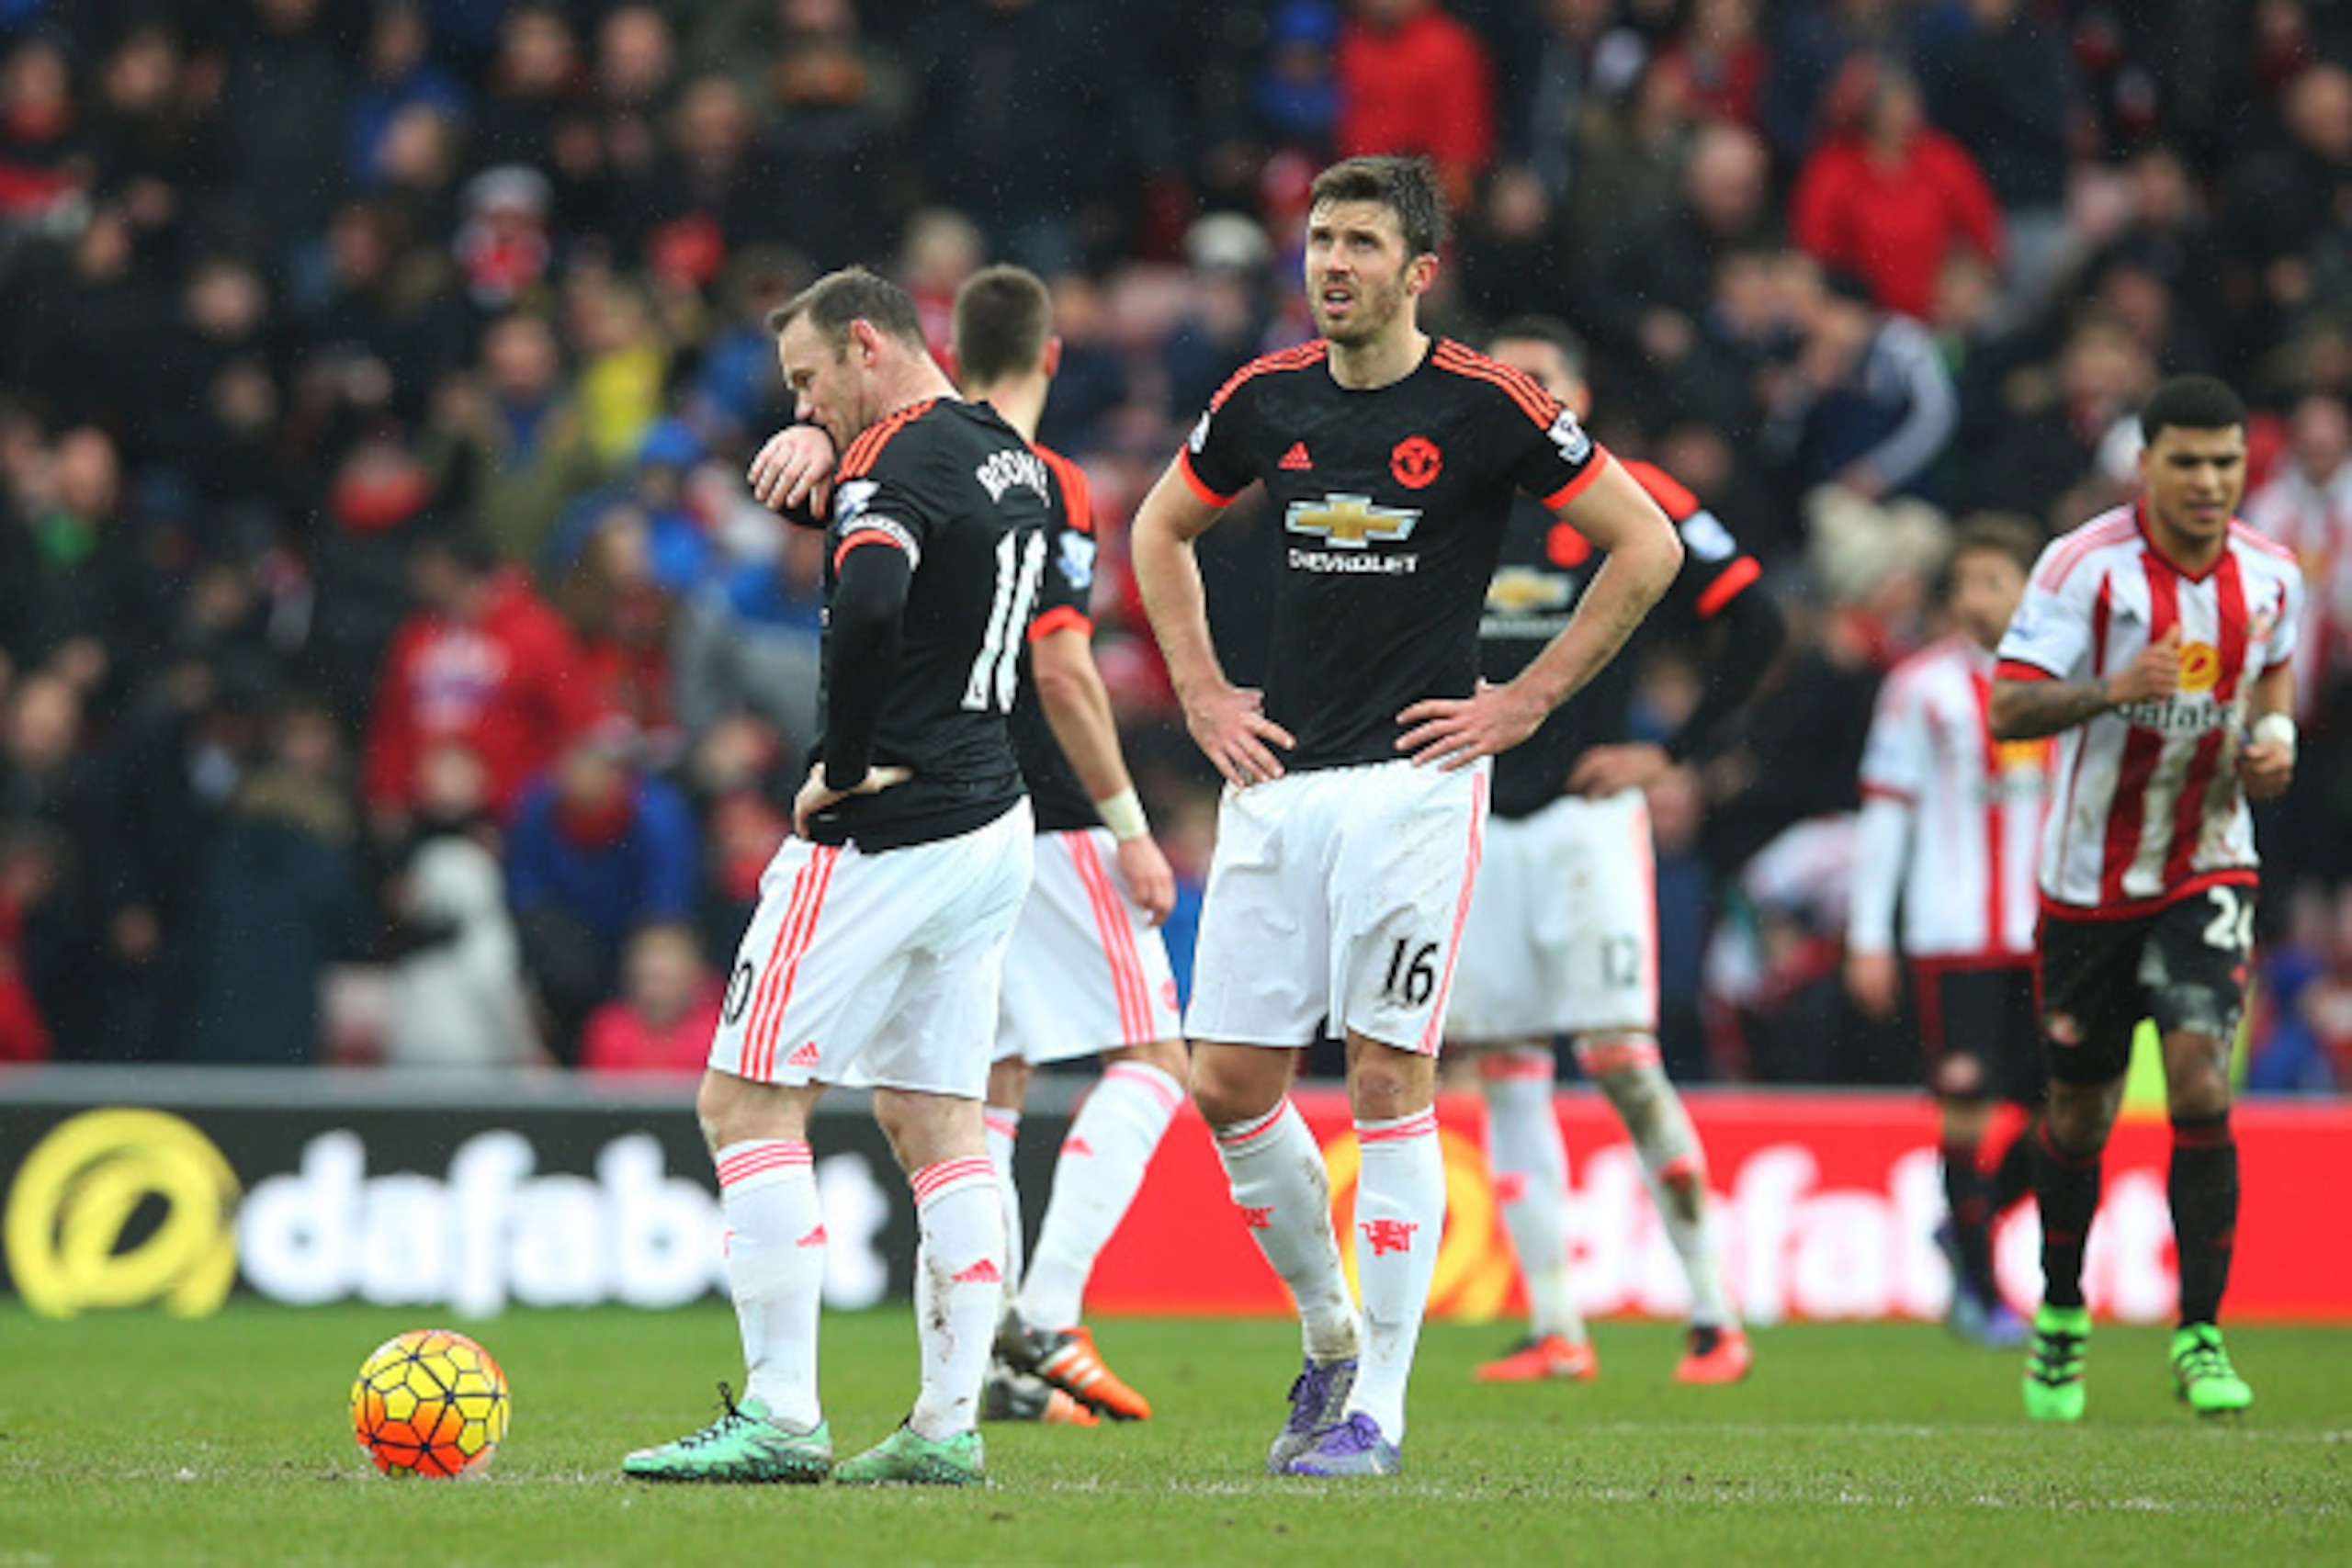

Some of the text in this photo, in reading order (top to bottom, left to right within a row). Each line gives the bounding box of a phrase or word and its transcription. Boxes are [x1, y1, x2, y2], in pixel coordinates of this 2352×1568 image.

[976, 449, 1051, 509] ROON
[1381, 937, 1440, 1007] 16
[235, 1129, 889, 1319] dafabt
